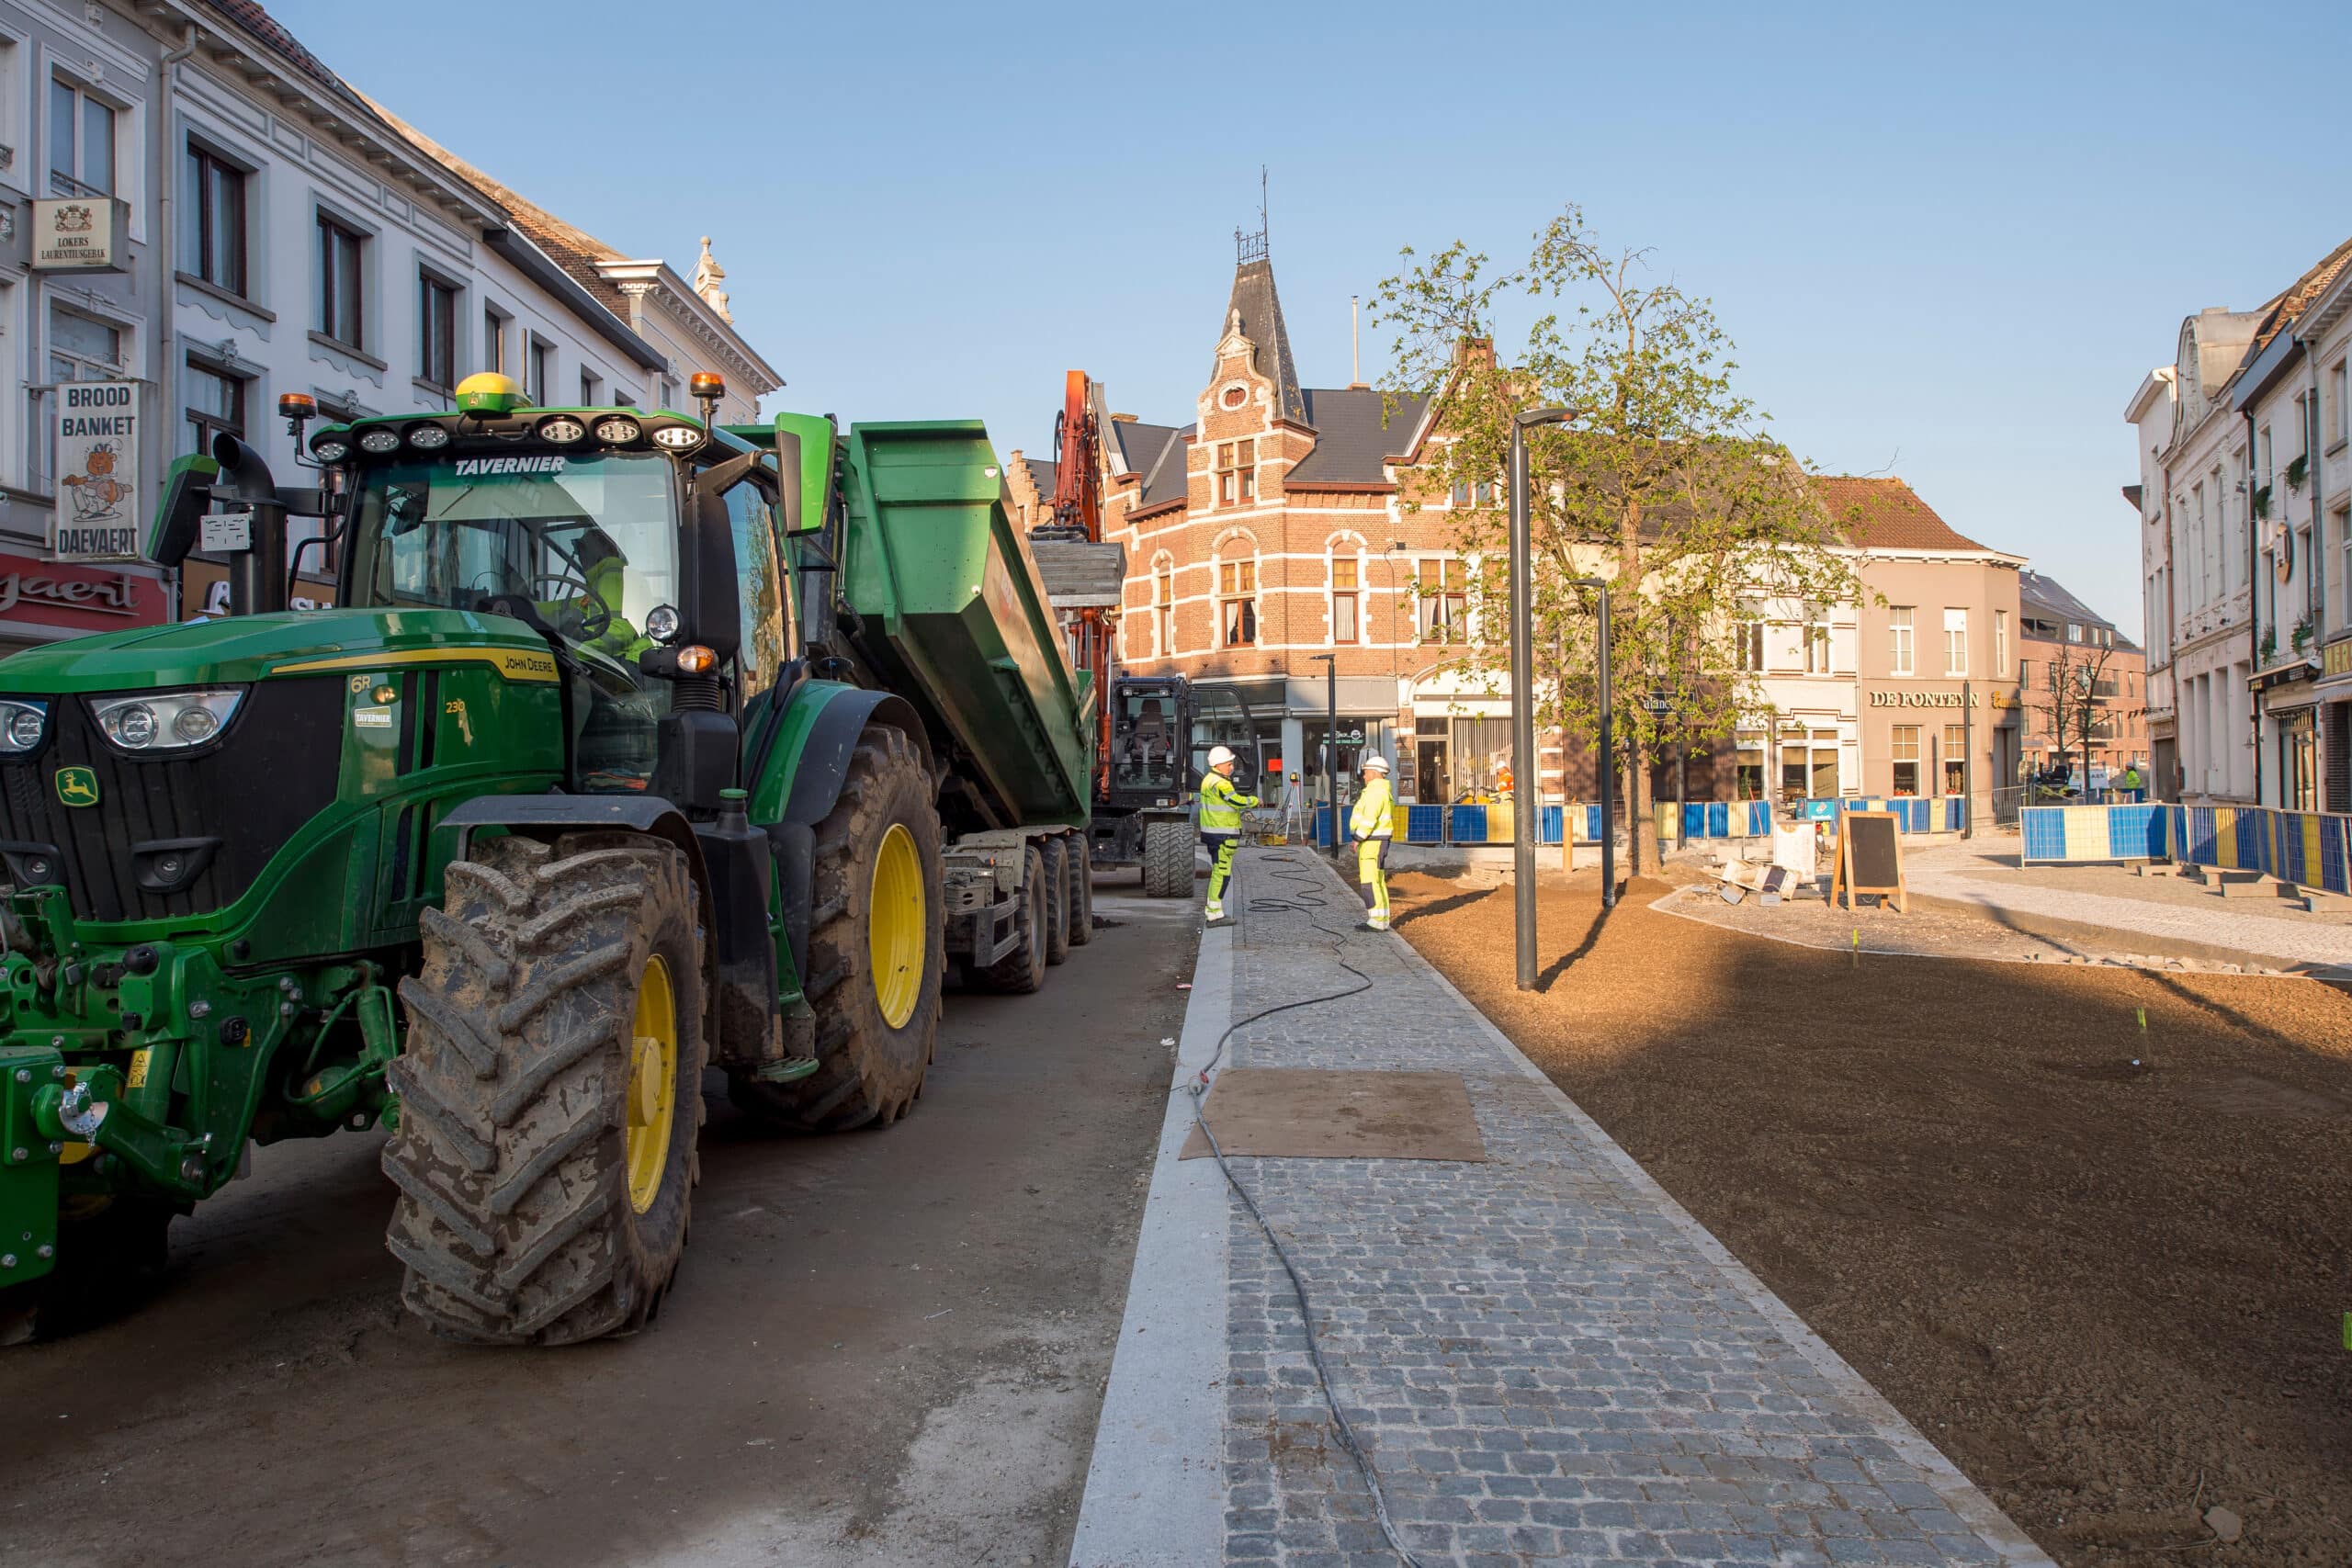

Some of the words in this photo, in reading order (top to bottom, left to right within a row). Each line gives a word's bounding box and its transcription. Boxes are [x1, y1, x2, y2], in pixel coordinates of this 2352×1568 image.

[58, 237, 89, 248] LOKERS
[68, 387, 130, 408] BROOD
[62, 416, 135, 436] BANKET
[456, 456, 566, 476] TAVERNIER
[505, 656, 526, 670] JOHN
[527, 658, 553, 672] DEERE
[351, 676, 371, 694] 6R
[1871, 691, 1896, 707] DE
[446, 701, 465, 714] 230
[356, 714, 390, 722] TAVERNIER
